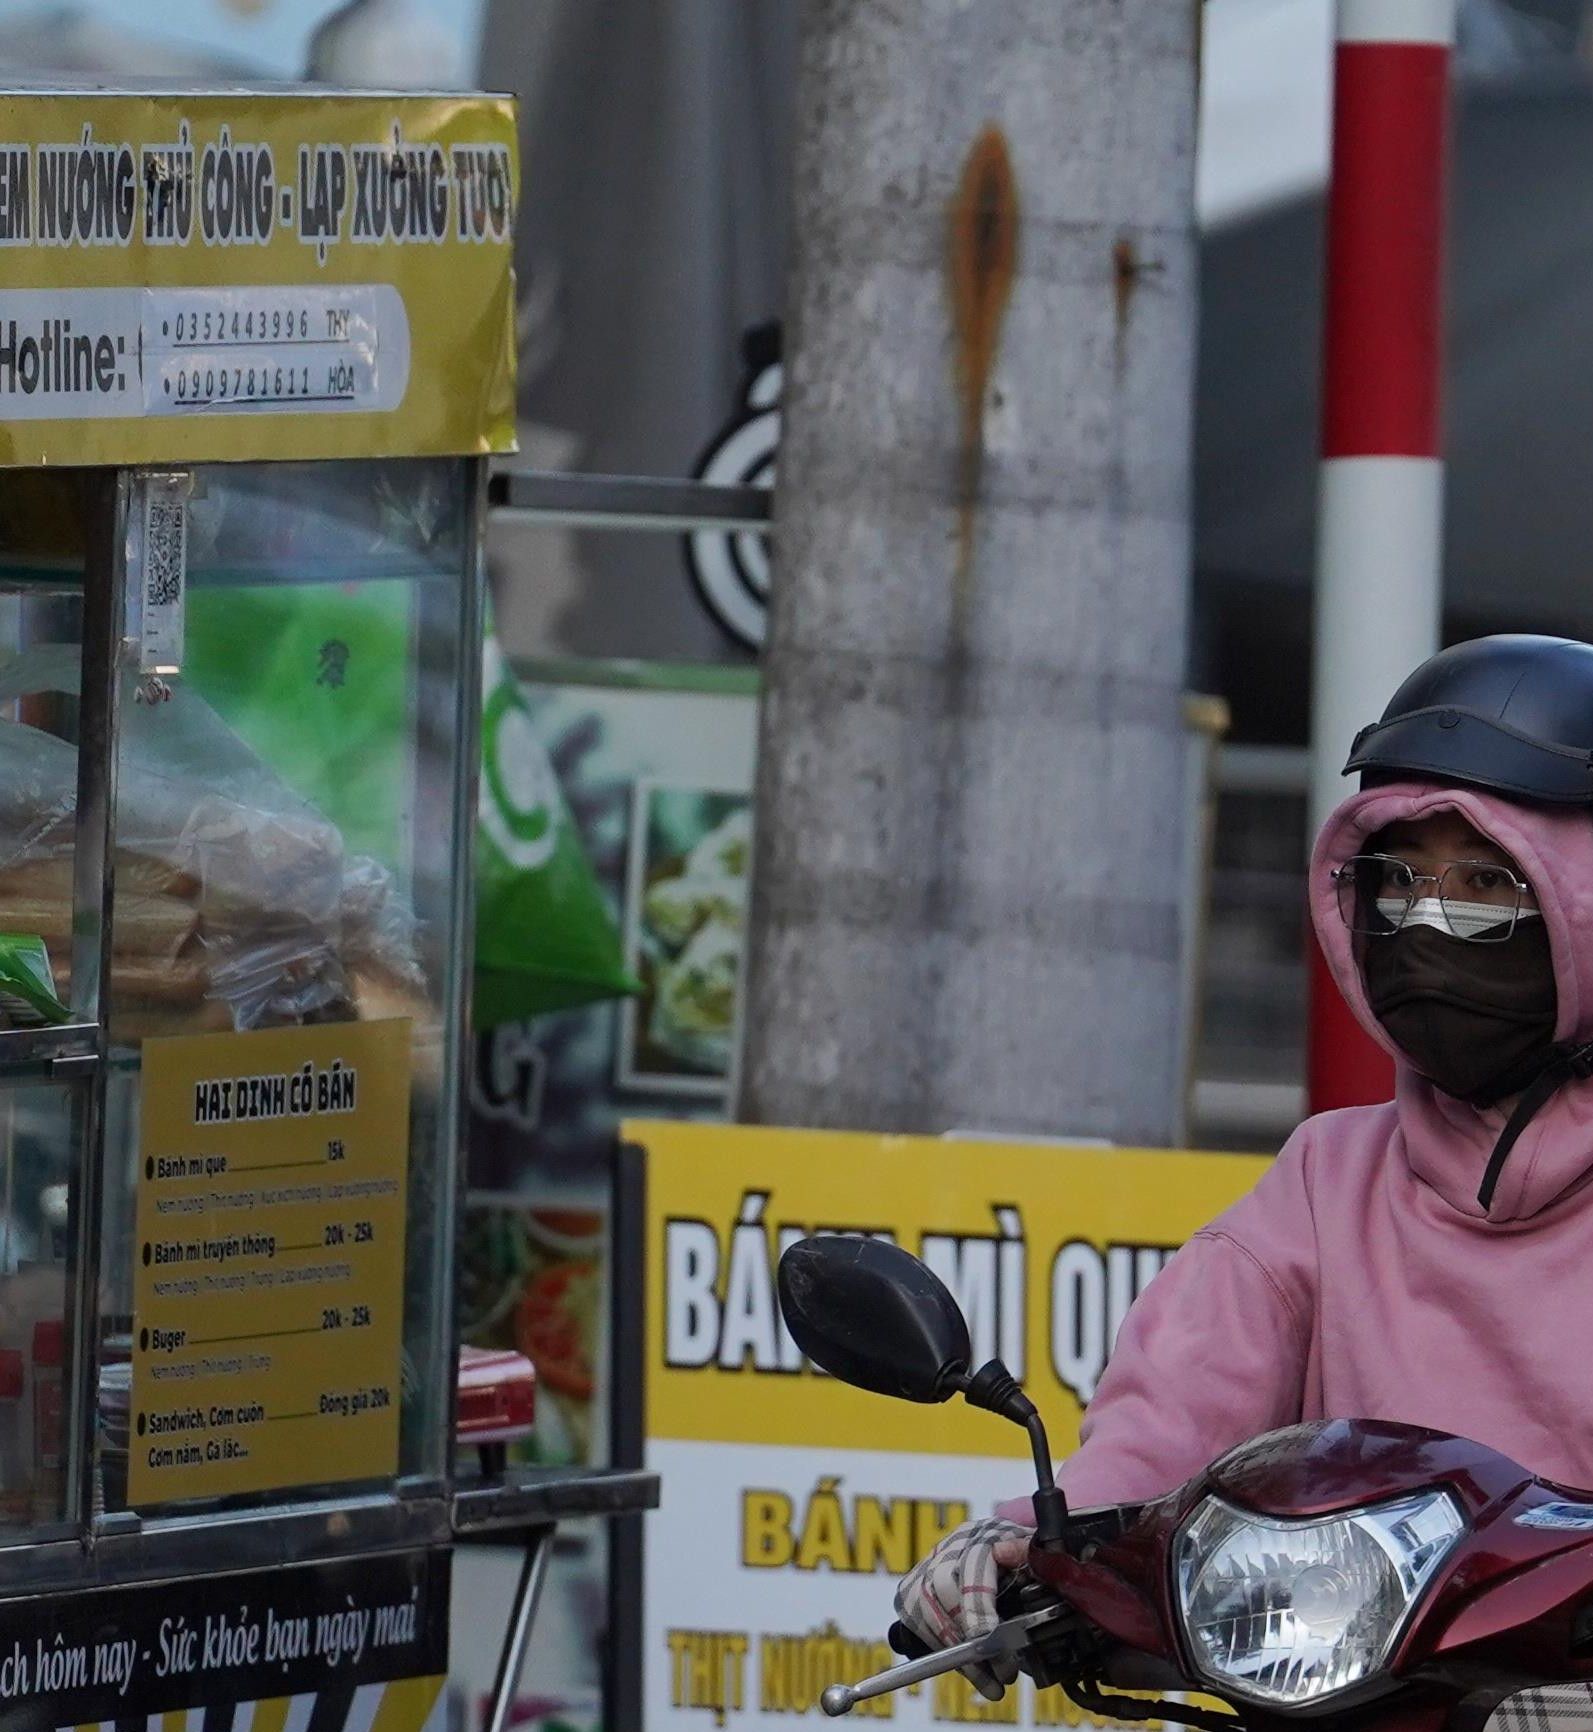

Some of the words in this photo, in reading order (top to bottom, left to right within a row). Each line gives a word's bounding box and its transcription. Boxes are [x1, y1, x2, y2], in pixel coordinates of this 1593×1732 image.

[39, 127, 134, 242] NƯỚNG
[205, 129, 272, 242] CÔNG
[300, 149, 346, 260] LẠP
[194, 1082, 232, 1122] HAI
[235, 1077, 286, 1119] DINH
[290, 1062, 314, 1114] CÓ
[317, 1060, 356, 1112] BÁN
[205, 1156, 227, 1179] que
[324, 1223, 345, 1247] 20k
[920, 1203, 1026, 1388] MÌ
[1051, 1235, 1180, 1410] QU
[151, 1328, 186, 1354] Buger
[35, 1632, 88, 1692] hôm
[93, 1638, 138, 1697] nay
[156, 1618, 199, 1678] Sức
[206, 1606, 260, 1670] khỏe
[266, 1607, 310, 1673] bạn
[315, 1595, 371, 1668] ngày
